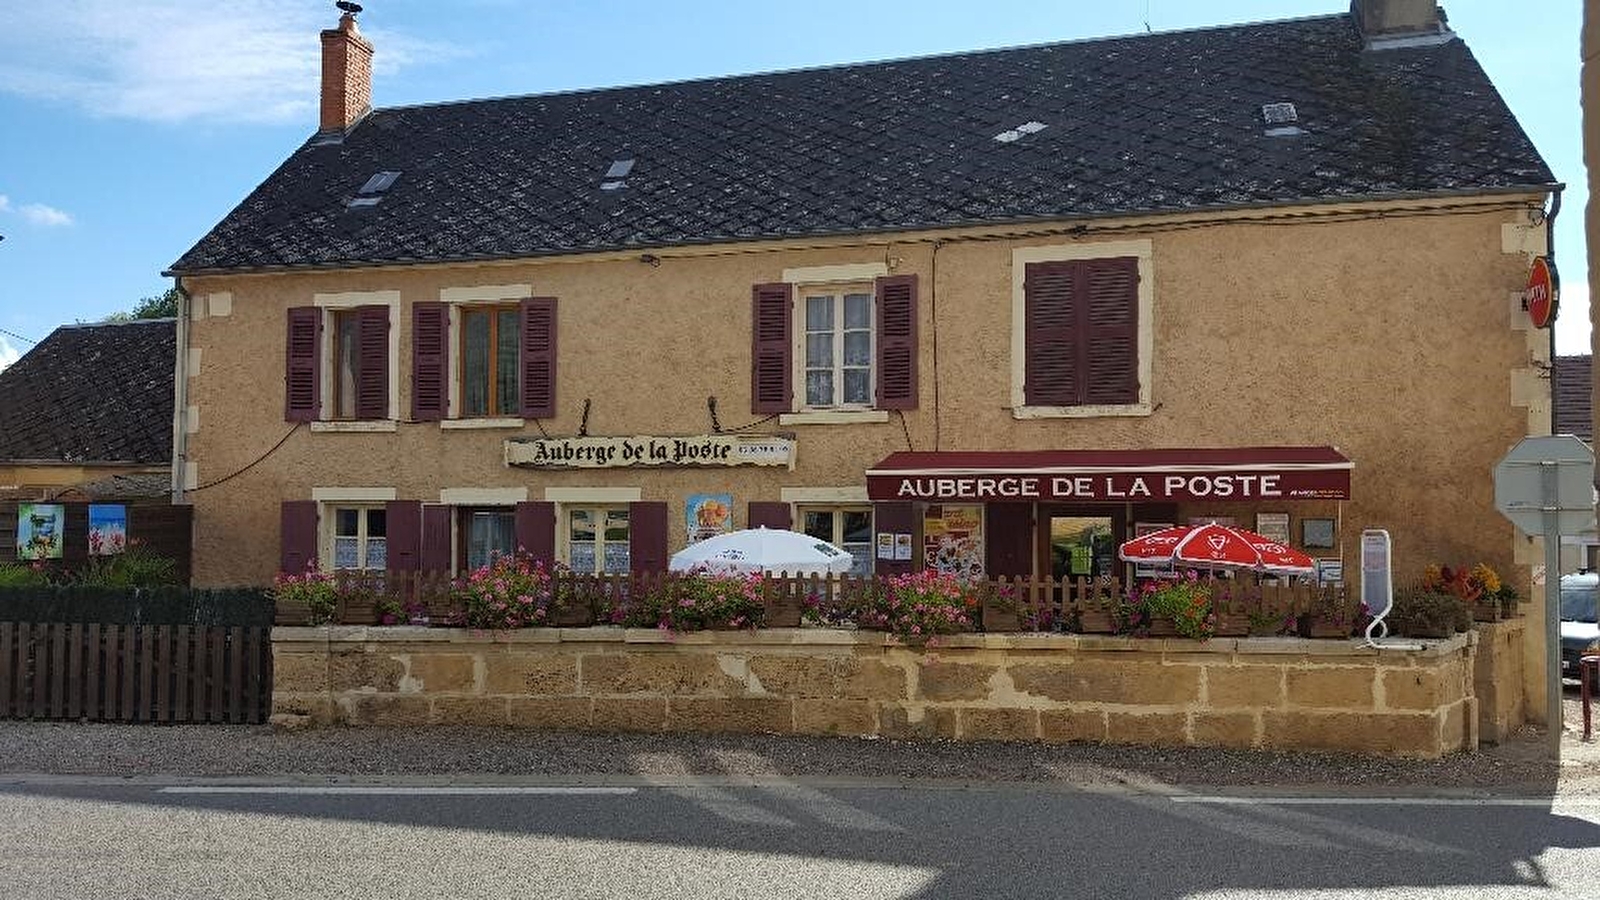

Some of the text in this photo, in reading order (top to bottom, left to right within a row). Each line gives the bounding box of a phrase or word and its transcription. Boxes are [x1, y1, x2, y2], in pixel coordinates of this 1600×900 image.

[534, 440, 731, 464] Auberge de la Poste
[898, 478, 1040, 498] AUBERGE
[1052, 478, 1095, 498] DE
[1106, 477, 1151, 497] LA
[1165, 475, 1282, 496] POSTE
